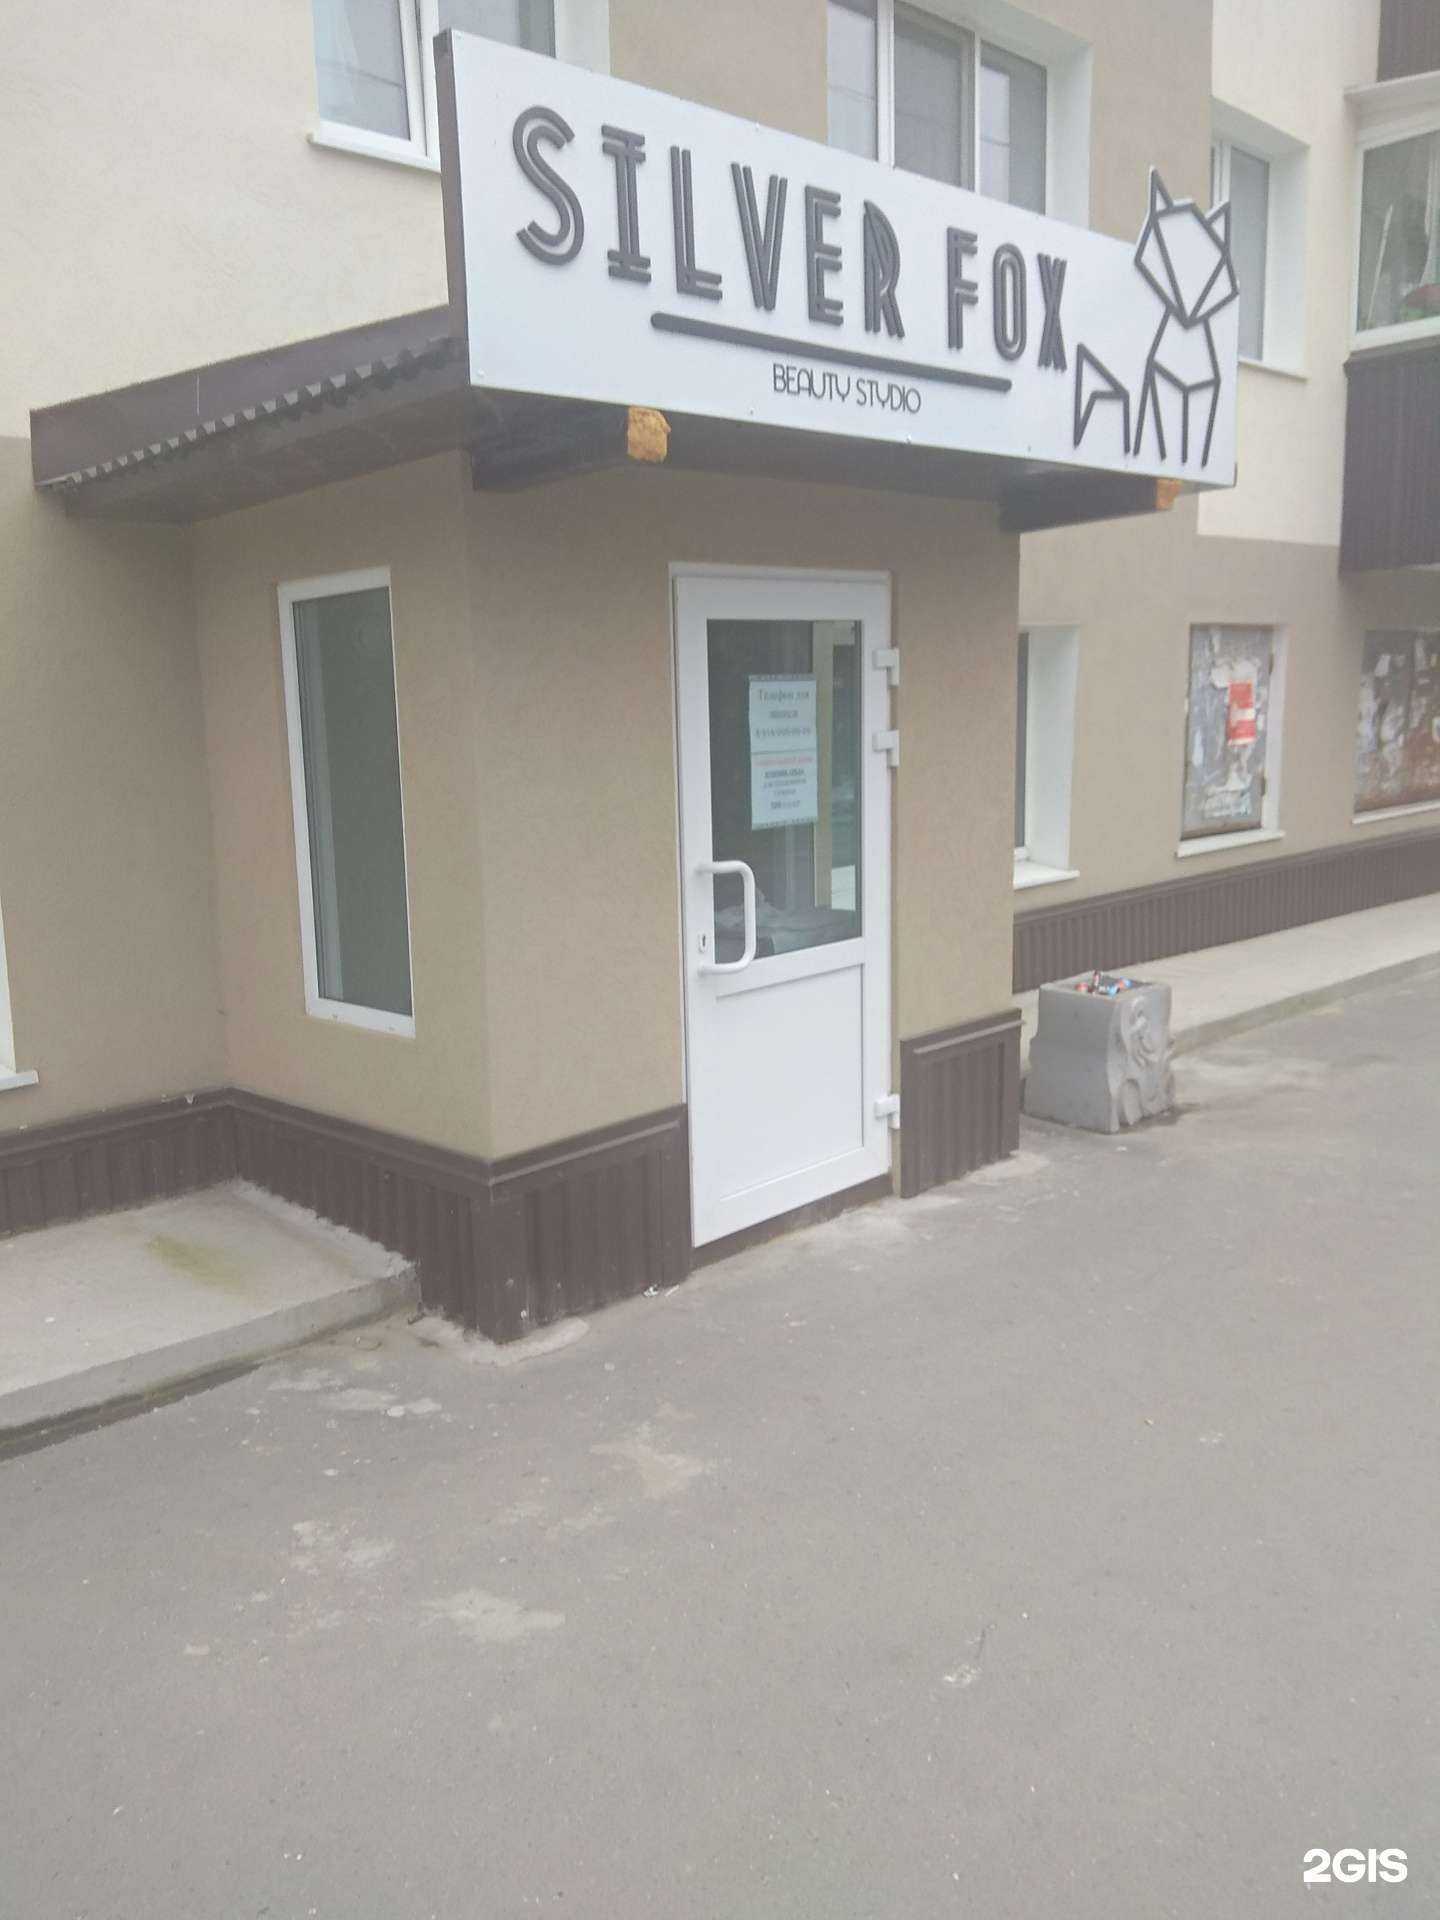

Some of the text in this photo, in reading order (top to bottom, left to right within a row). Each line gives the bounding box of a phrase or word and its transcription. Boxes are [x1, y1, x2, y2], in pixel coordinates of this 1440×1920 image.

[512, 105, 1067, 372] SILVER FOX
[773, 363, 921, 413] BEAUTY STYDIO
